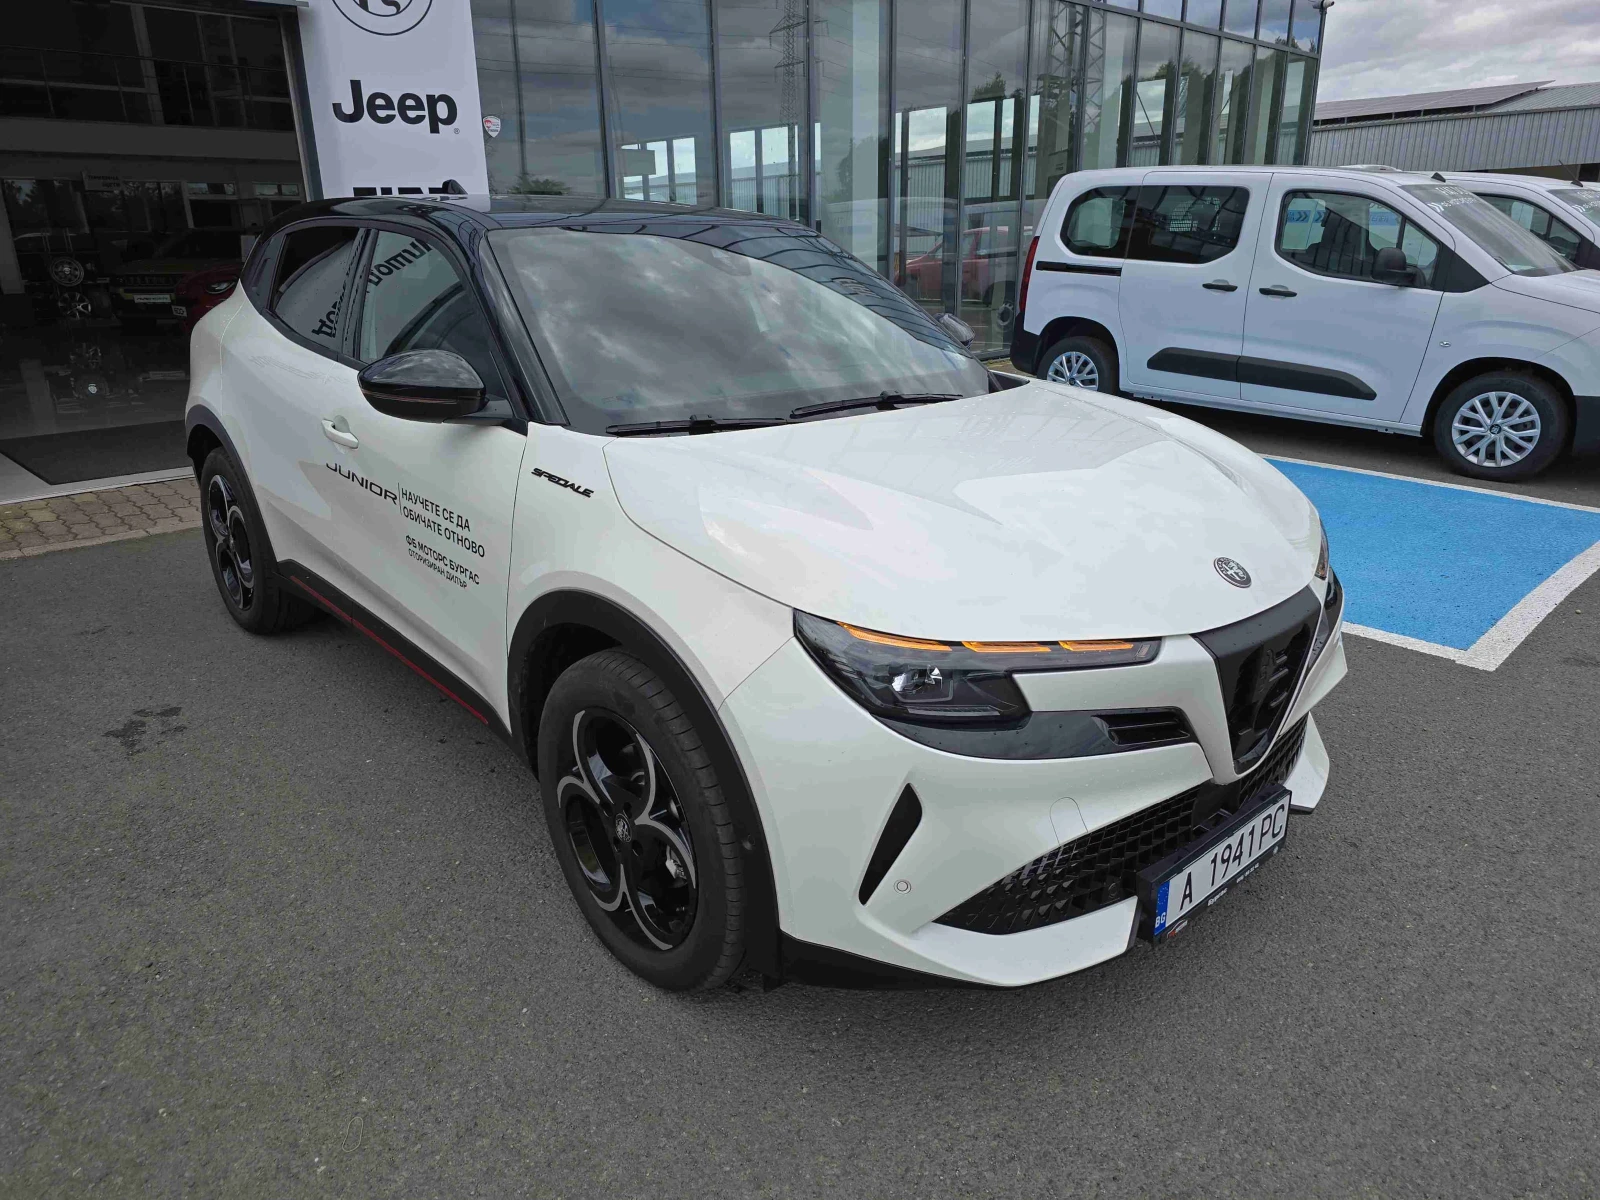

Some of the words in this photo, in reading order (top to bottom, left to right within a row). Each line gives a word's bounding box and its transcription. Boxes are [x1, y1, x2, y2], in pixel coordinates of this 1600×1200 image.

[332, 80, 457, 134] Jeep
[326, 463, 397, 505] JUNIOR
[401, 488, 440, 517] НАУЧЕТЕ
[442, 508, 454, 524] СЕ
[456, 514, 470, 532] ДА
[403, 506, 442, 536] ОБИЧАТЕ
[444, 527, 485, 558] ОТНОВО
[405, 535, 417, 548] ФБ
[418, 541, 448, 567] МОТОРС
[449, 559, 480, 585] БУРГАС
[408, 548, 445, 577] ОТОРИЗИРАН
[1179, 871, 1193, 912] A
[1155, 912, 1166, 928] BG
